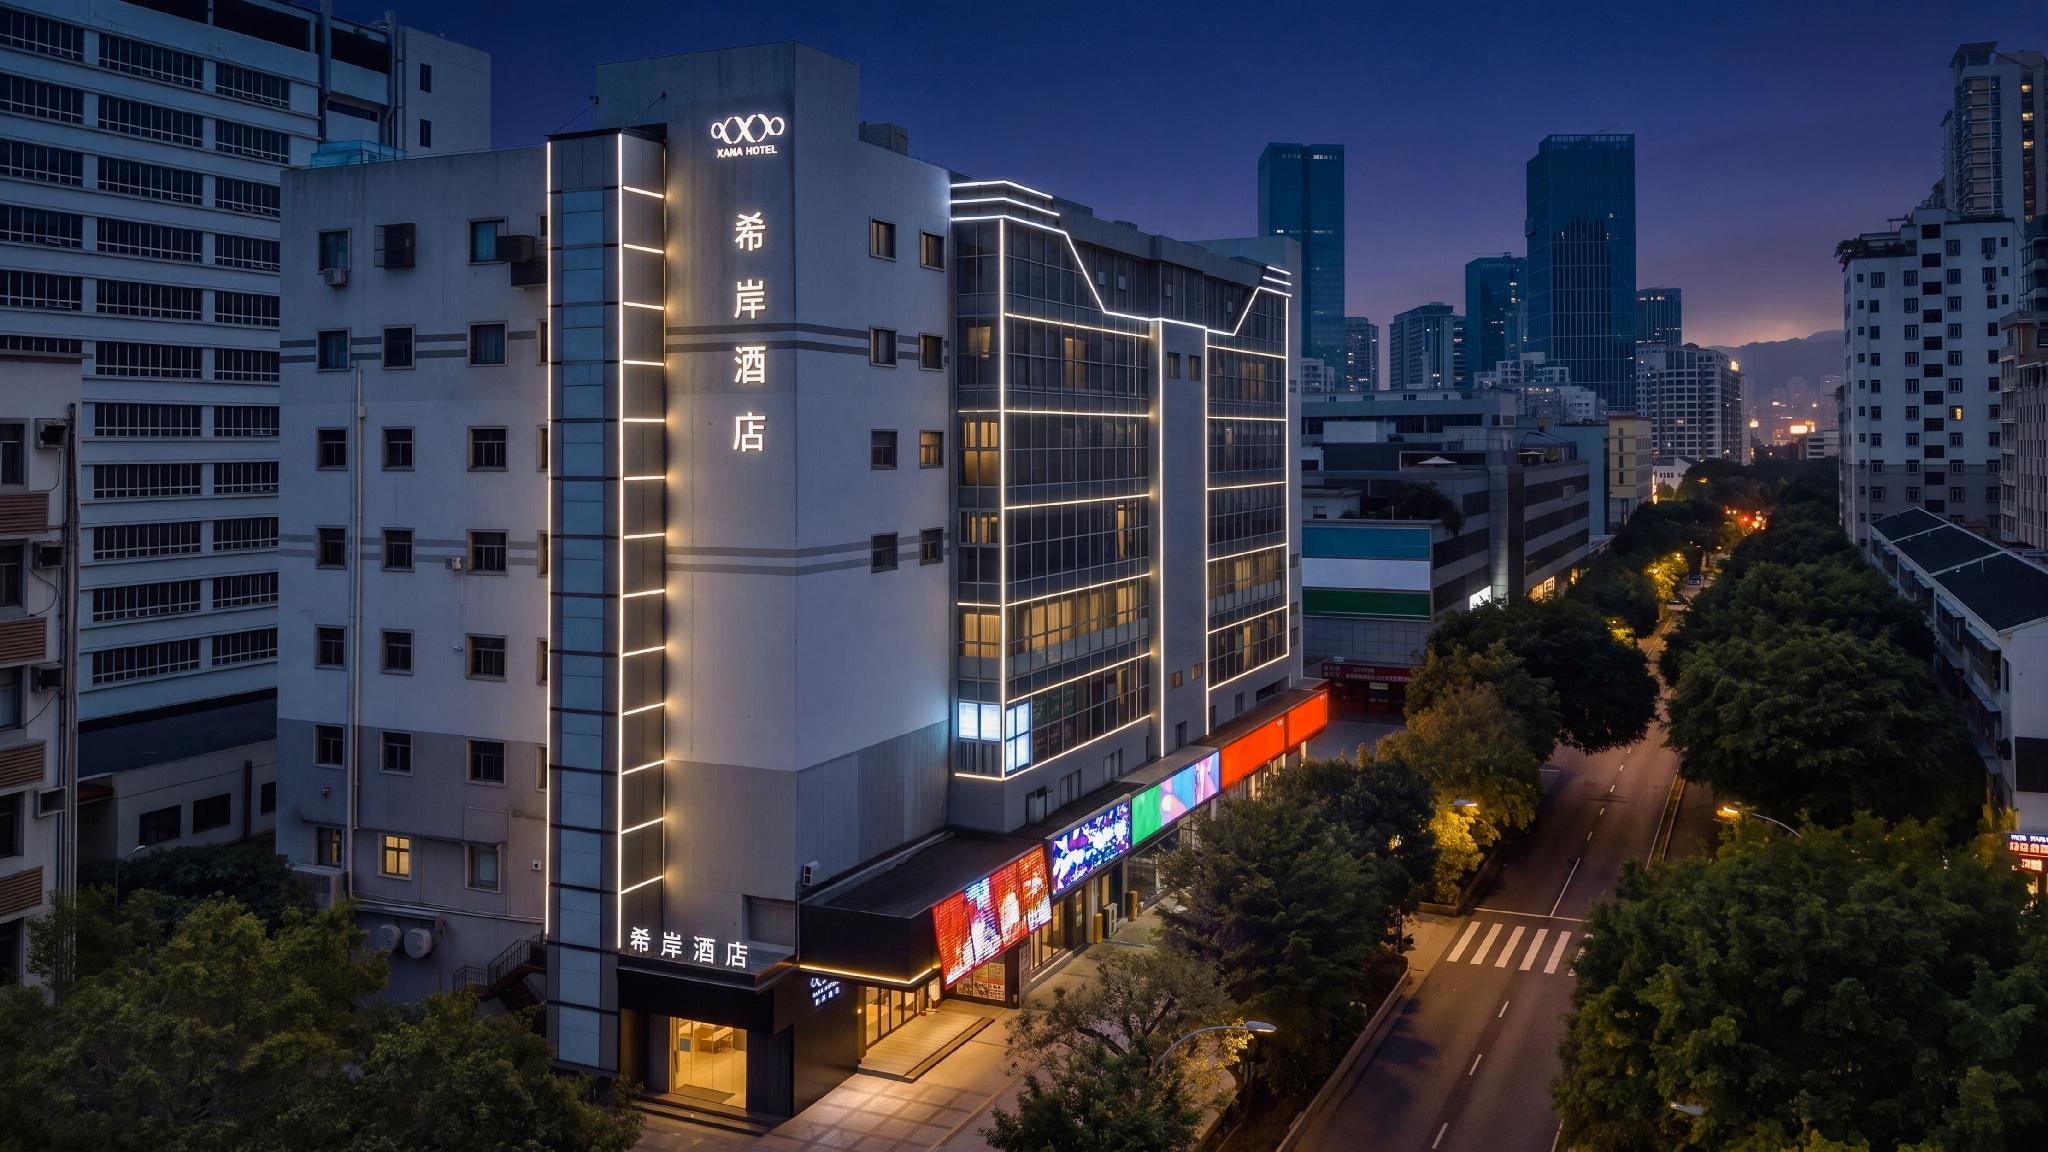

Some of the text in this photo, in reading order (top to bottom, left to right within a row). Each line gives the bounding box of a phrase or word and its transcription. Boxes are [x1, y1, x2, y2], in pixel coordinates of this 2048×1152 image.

[717, 145, 778, 158] XANA HOTEL
[732, 211, 767, 453] 希岸酒店
[630, 927, 748, 969] 希岸酒店
